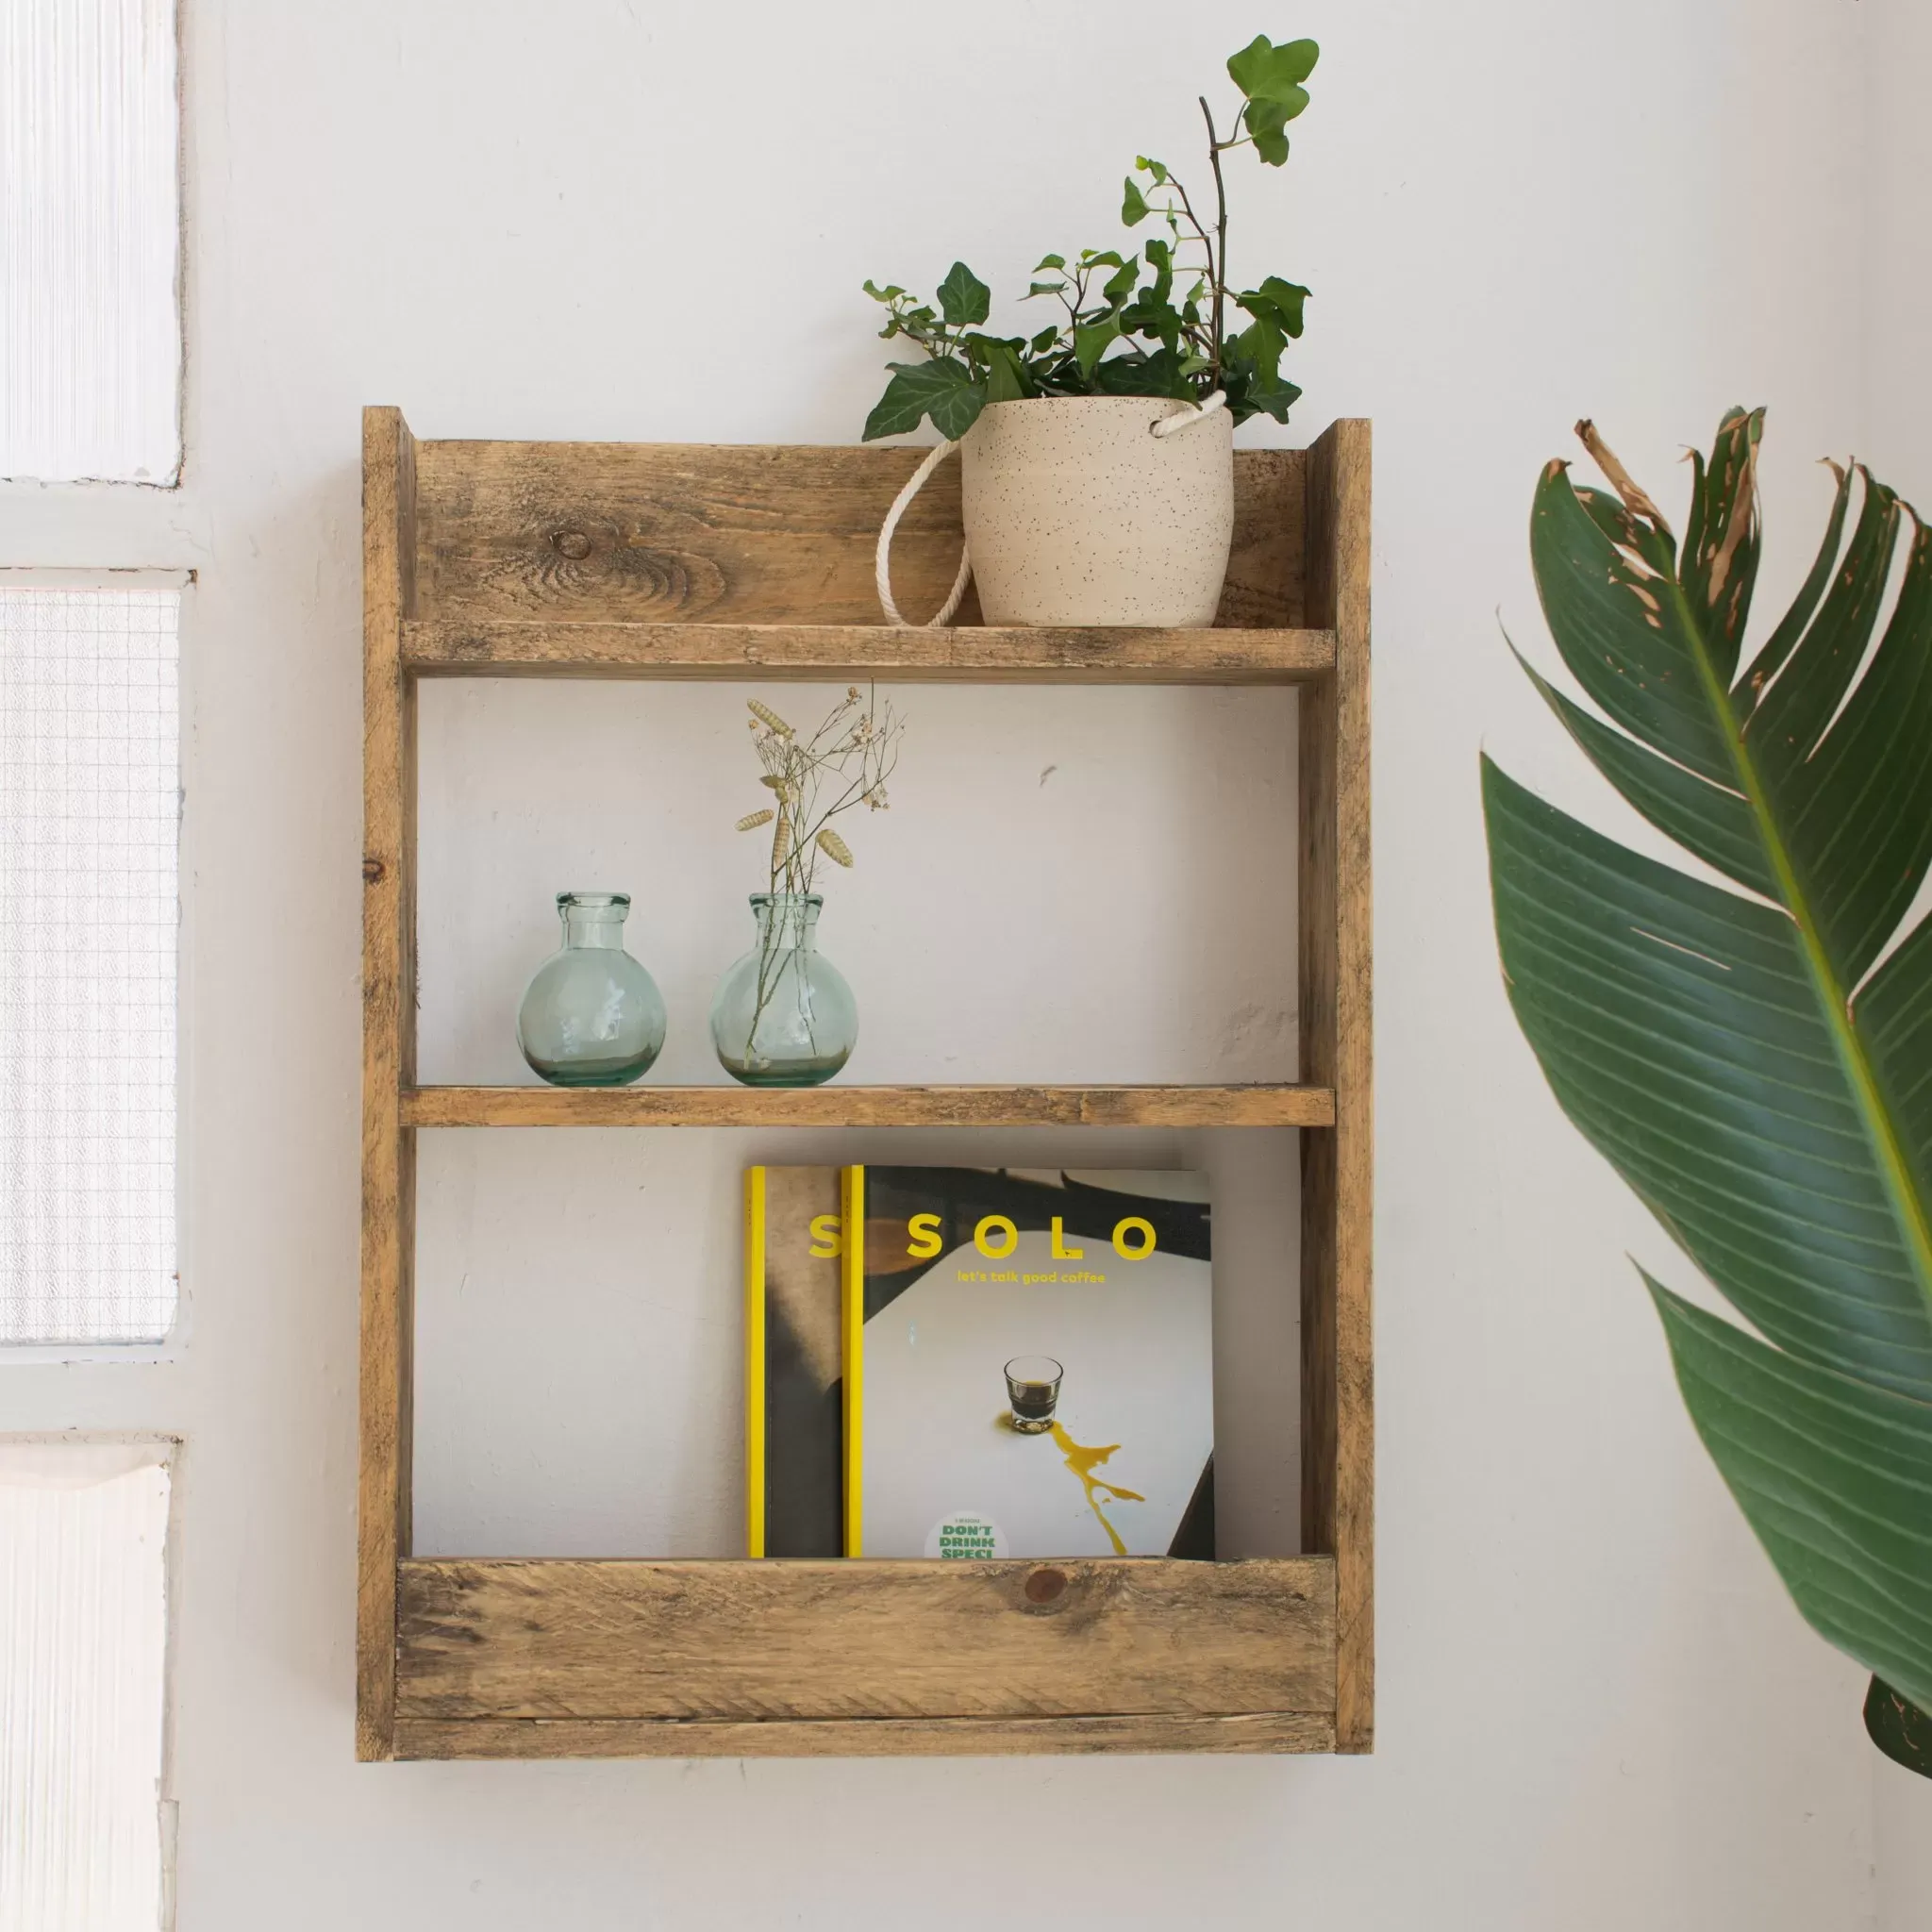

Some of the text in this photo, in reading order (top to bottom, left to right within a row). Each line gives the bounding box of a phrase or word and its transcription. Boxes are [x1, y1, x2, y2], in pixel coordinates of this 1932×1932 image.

[907, 1213, 1157, 1261] SOLO
[958, 1270, 1106, 1285] let's talk good coffee
[942, 1525, 992, 1536] DON'T
[940, 1537, 995, 1548] DRINK
[941, 1548, 992, 1559] SPECI
